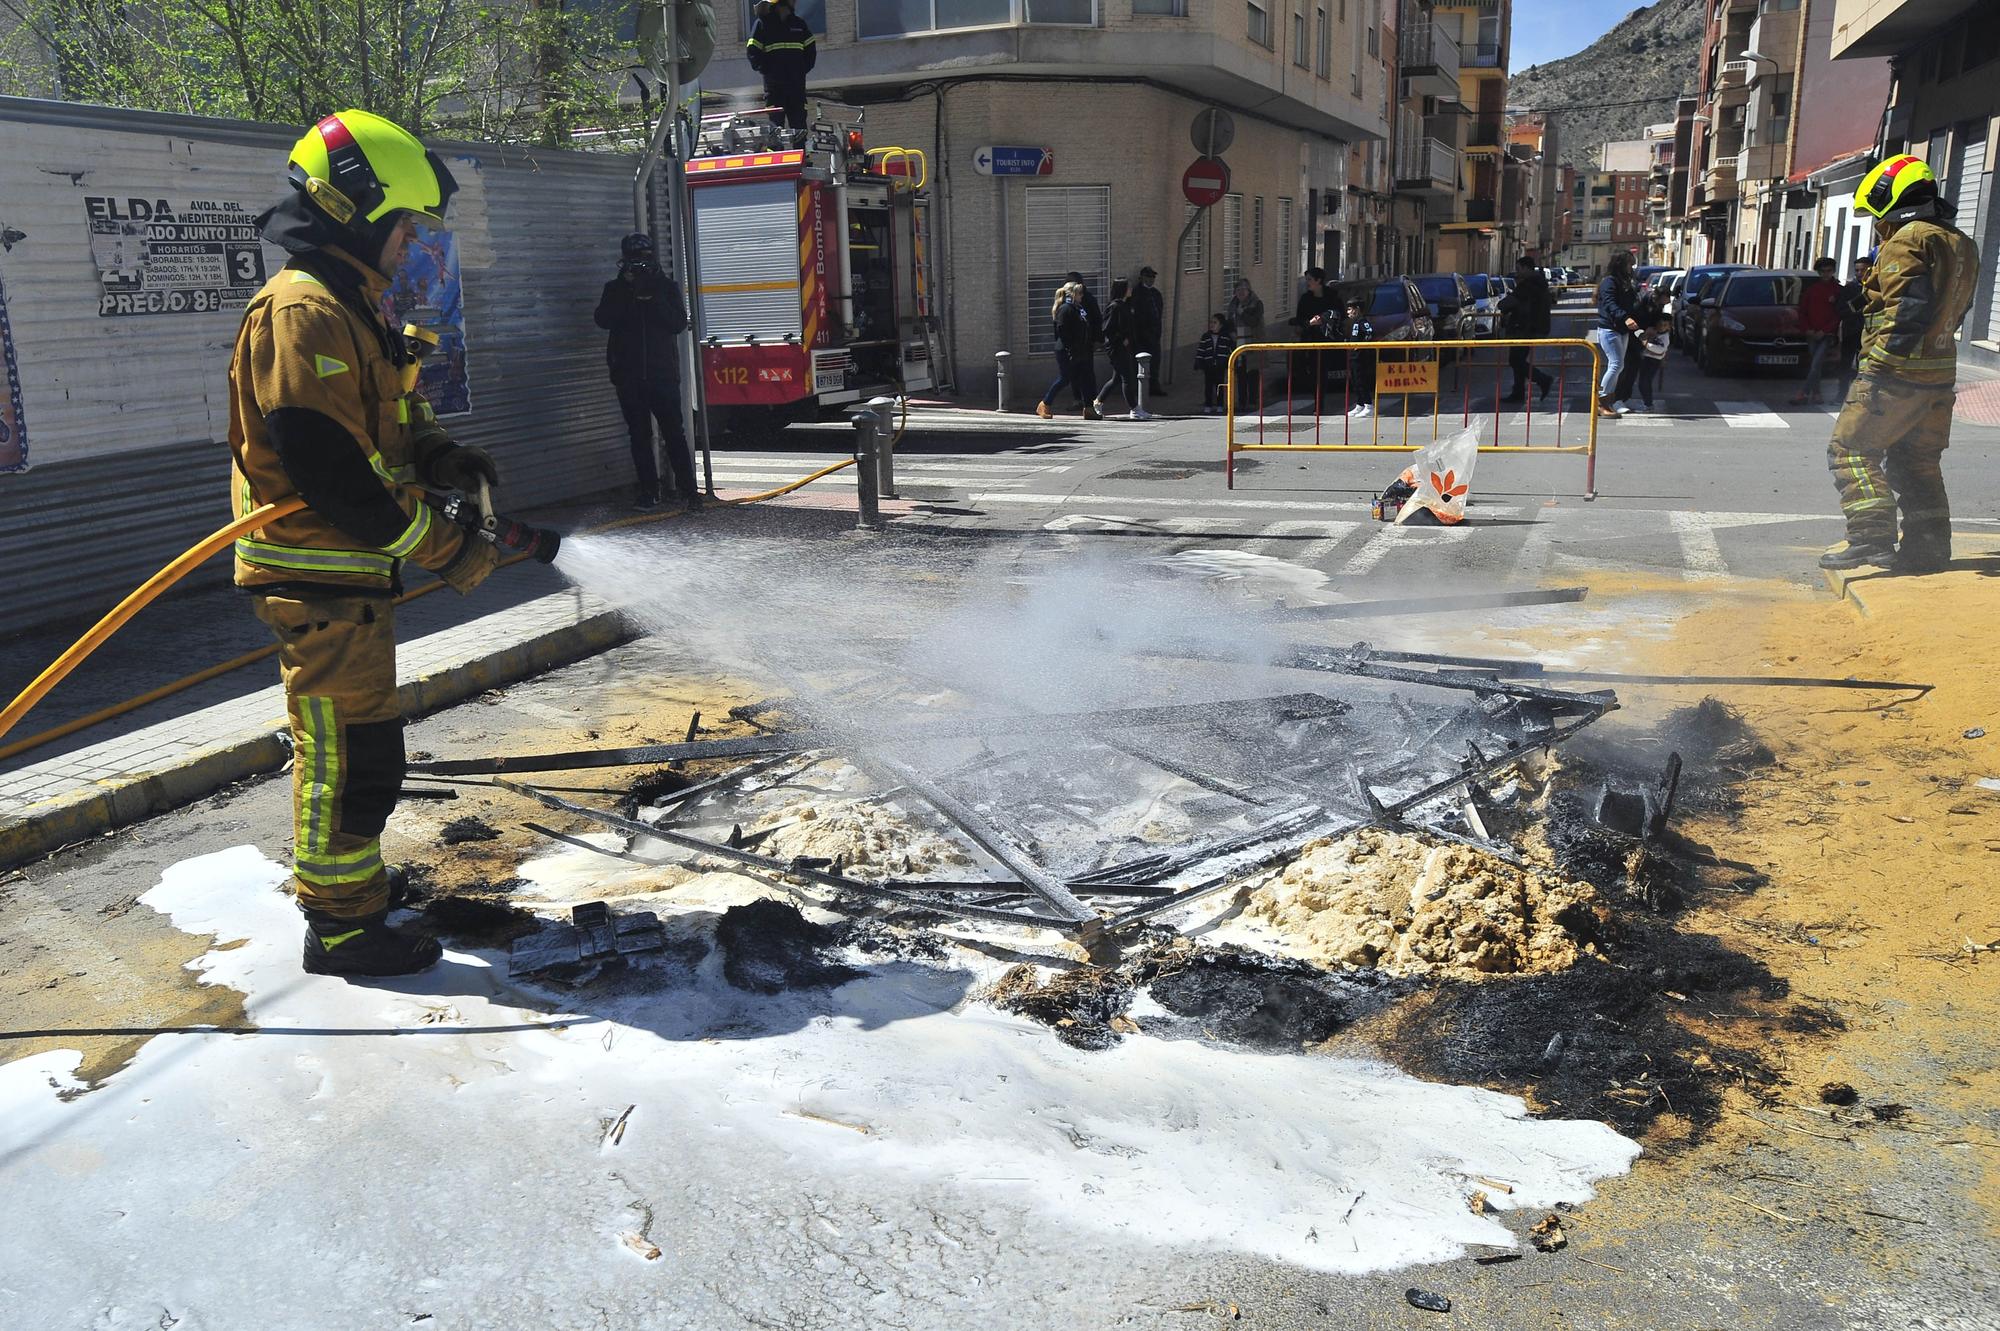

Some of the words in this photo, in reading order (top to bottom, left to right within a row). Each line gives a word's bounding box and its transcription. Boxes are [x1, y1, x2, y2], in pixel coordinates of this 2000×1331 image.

[996, 159, 1020, 167] TOURIST
[1021, 159, 1035, 167] INFO
[84, 197, 177, 223] ELDA
[190, 200, 221, 212] AVDA.
[223, 202, 244, 212] DEL
[146, 226, 176, 241] ADO
[180, 226, 226, 241] JUNTO
[230, 227, 259, 241] LIDL
[813, 190, 825, 276] Bombers
[157, 245, 206, 254] HORARIOS
[235, 251, 257, 280] 3
[816, 330, 830, 344] 411
[721, 367, 749, 385] 112
[1387, 364, 1427, 374] ELDA
[1383, 377, 1428, 388] OBRAS
